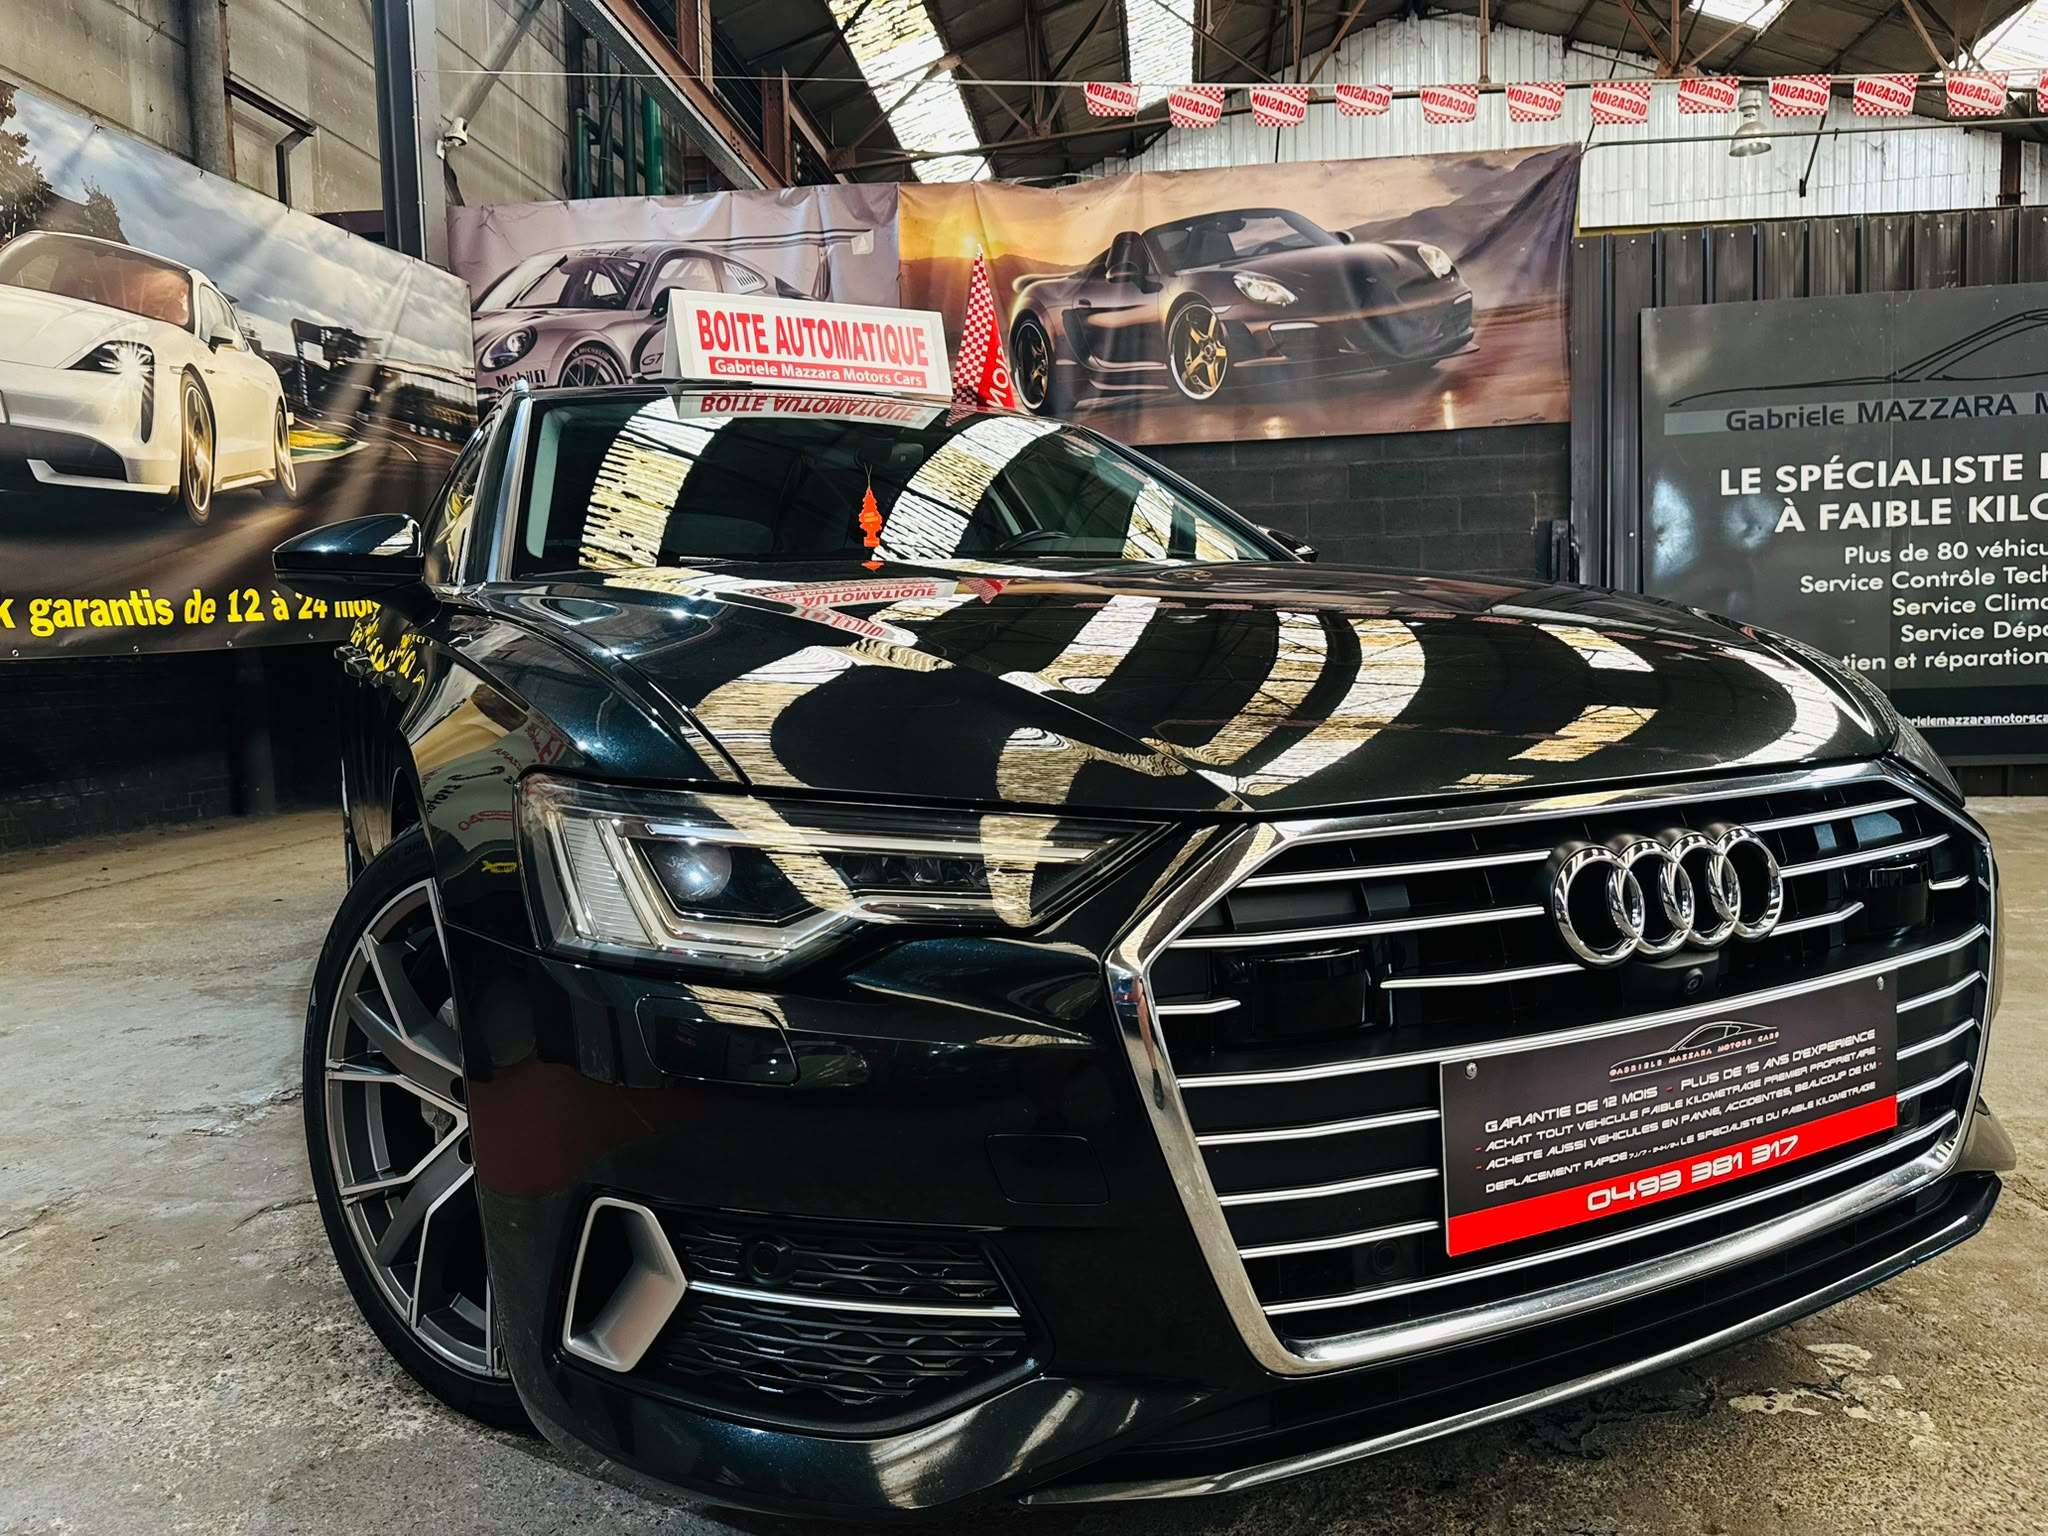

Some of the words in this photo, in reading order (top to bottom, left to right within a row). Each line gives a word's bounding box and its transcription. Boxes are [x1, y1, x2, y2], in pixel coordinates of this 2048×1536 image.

[696, 309, 770, 354] BOITE
[775, 315, 929, 366] AUTOMATIQUE
[714, 359, 778, 376] Gabriele
[781, 364, 840, 381] Mazzara
[843, 368, 891, 385] Motors
[893, 371, 923, 387] Cars
[1726, 405, 1844, 431] Gabriele
[1857, 394, 2017, 424] MAZZARA
[1721, 468, 1761, 496] LE
[1775, 454, 2024, 494] SPÉCIALISTE
[1775, 498, 1806, 533] À
[1819, 498, 1952, 531] FAIBLE
[1844, 545, 1891, 565] Plus
[1900, 543, 1929, 562] de
[1937, 541, 1968, 560] 80
[1976, 539, 2048, 558] véhicu
[1800, 574, 1884, 593] Service
[1892, 567, 1996, 590] Contrôle
[2003, 565, 2048, 584] Tech
[29, 588, 174, 637] garantis
[184, 588, 217, 624] de
[227, 588, 265, 622] 12
[271, 589, 290, 621] à
[294, 591, 328, 619] 24
[1892, 596, 1977, 616] Service
[1901, 622, 1985, 643] Service
[1894, 653, 1918, 670] et
[1485, 1105, 1571, 1133] GARANTIE
[1575, 1100, 1599, 1114] DE
[1602, 1095, 1618, 1109] 12
[1621, 1086, 1658, 1105] MOIS
[1681, 1071, 1719, 1091] PLUS
[1723, 1066, 1743, 1081] DE
[1745, 1061, 1760, 1076] 15
[1763, 1053, 1790, 1070] ANS
[1792, 1029, 1876, 1062] D'EXPERIENCE
[1485, 1133, 1532, 1153] ACHAT
[1536, 1124, 1573, 1141] TOUT
[1577, 1109, 1639, 1132] VEHICULE
[1641, 1098, 1684, 1118] FAIBLE
[1685, 1079, 1762, 1107] KILOMETRAGE
[1764, 1068, 1808, 1086] PREMIER
[1810, 1046, 1876, 1073] PROPRIETAIRE
[1485, 1149, 1543, 1171] ACHETE
[1546, 1140, 1587, 1158] AUSSI
[1590, 1122, 1659, 1148] VEHICULES
[1661, 1116, 1679, 1130] EN
[1681, 1105, 1722, 1123] PANNE,
[1725, 1088, 1792, 1114] ACCIDENTES,
[1795, 1070, 1847, 1093] BEAUCOUP
[1849, 1066, 1862, 1077] DE
[1863, 1061, 1877, 1073] KM
[1485, 1163, 1581, 1193] DEPLACEMENT
[1584, 1151, 1628, 1171] RAPIDE
[1681, 1133, 1695, 1147] LE
[1696, 1114, 1764, 1141] SPECIALISTE
[1765, 1111, 1780, 1122] DU
[1781, 1101, 1814, 1118] FAIBLE
[1815, 1081, 1876, 1107] KILOMETRAGE
[1586, 1169, 1682, 1212] 0493
[1691, 1152, 1743, 1183] 381
[1751, 1135, 1799, 1166] 317
